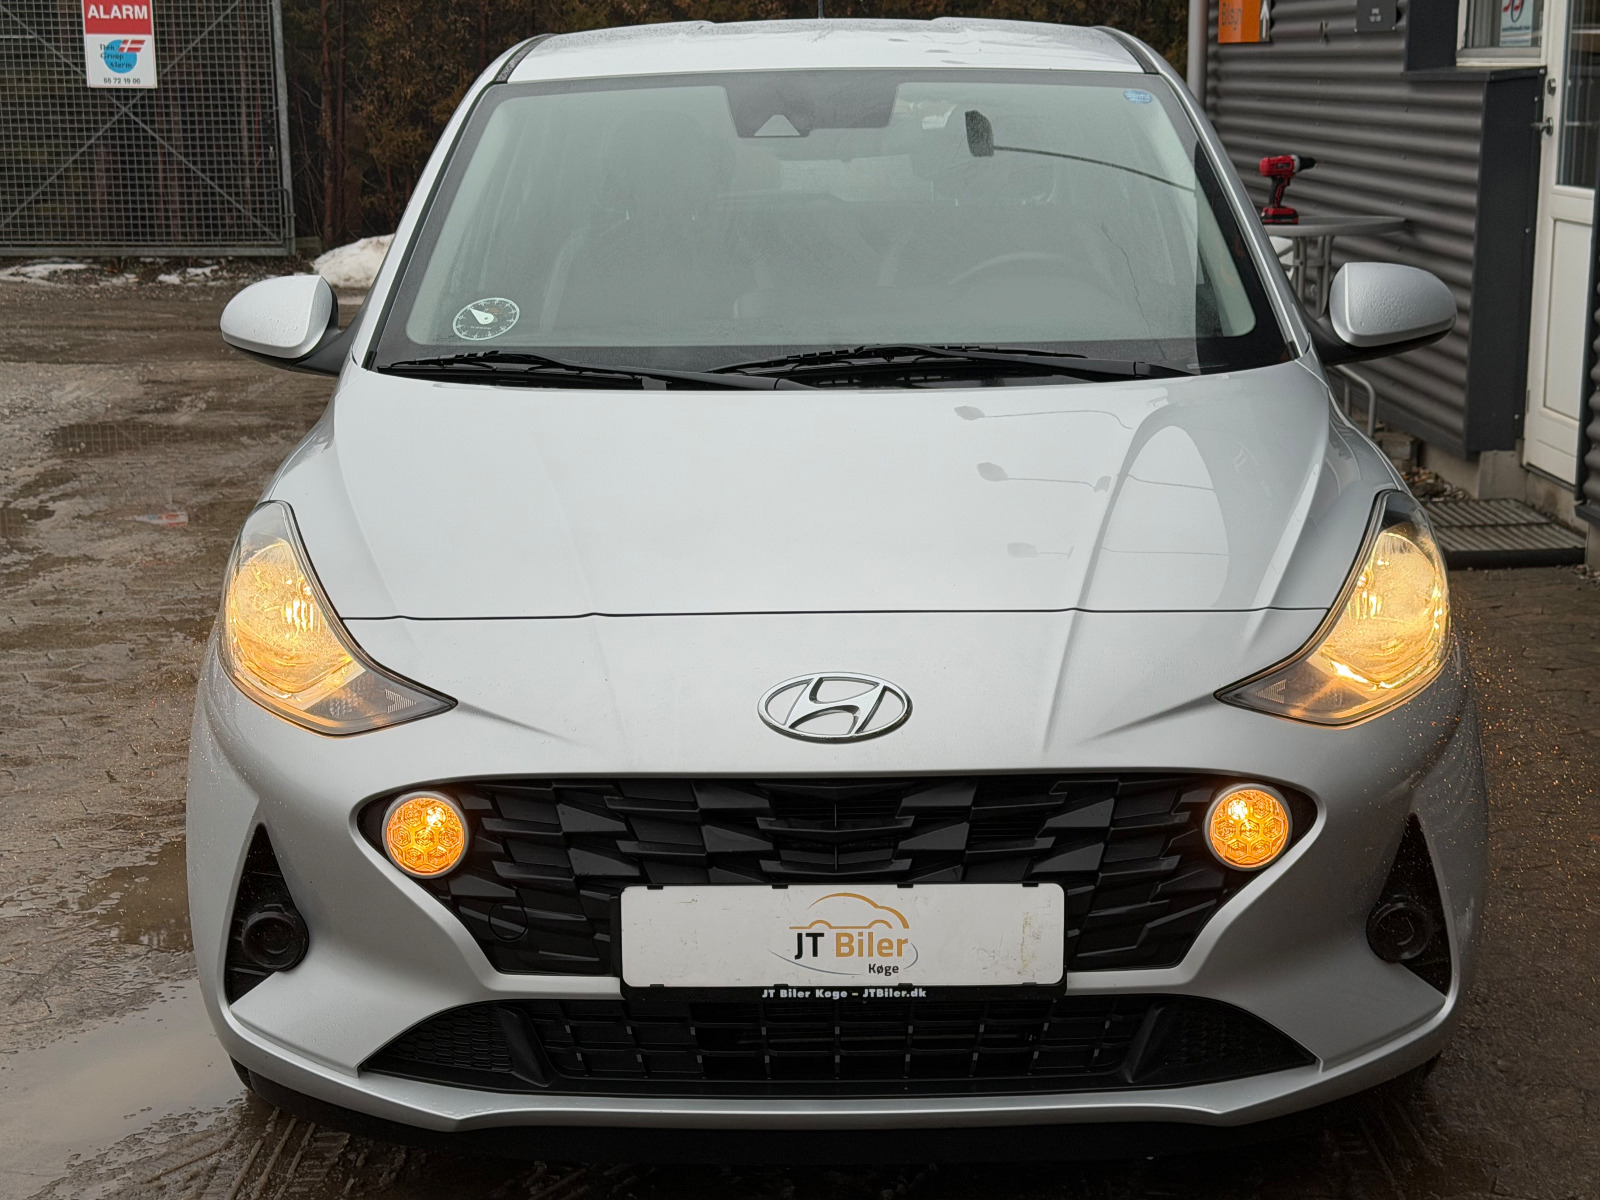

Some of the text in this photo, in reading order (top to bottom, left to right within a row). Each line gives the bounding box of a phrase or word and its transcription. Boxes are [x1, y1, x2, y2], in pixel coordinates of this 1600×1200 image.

[87, 4, 148, 20] ALARM
[794, 931, 909, 960] JT Biler
[868, 963, 900, 977] Køge
[761, 989, 776, 998] JT
[779, 988, 811, 998] Biler
[862, 988, 927, 998] JTBiler.dk
